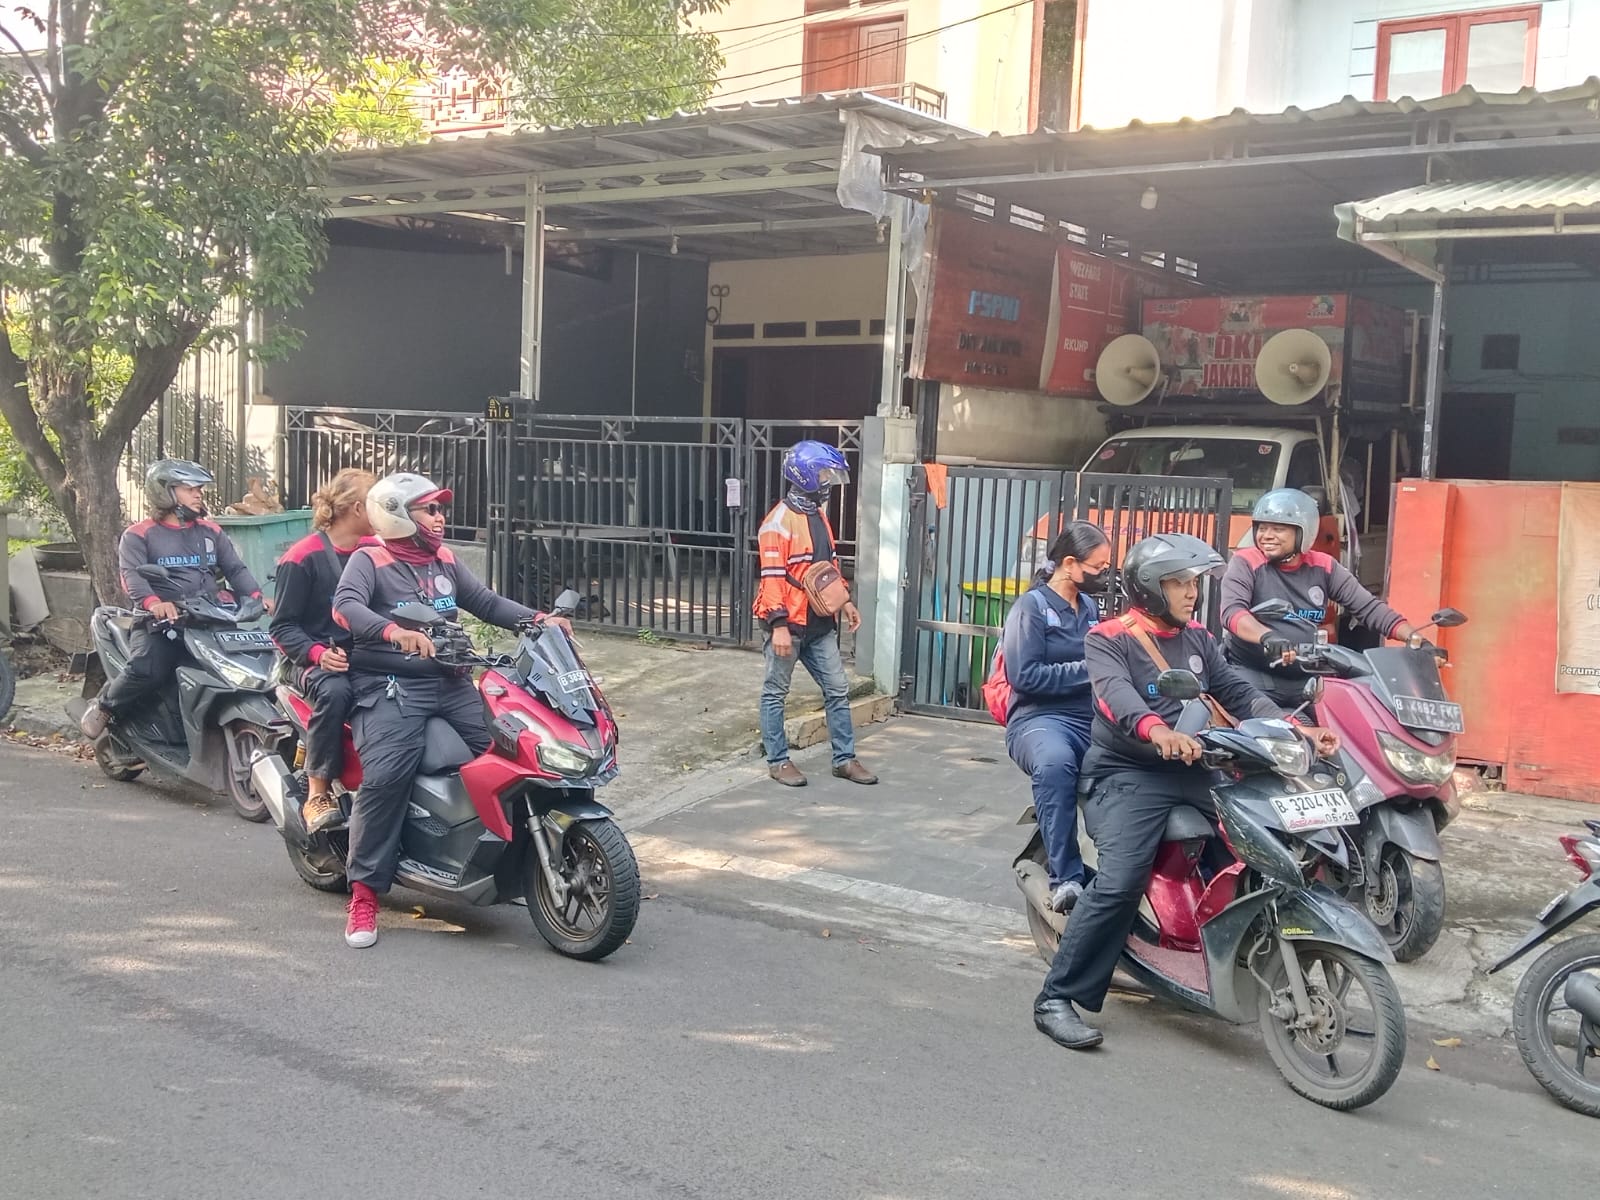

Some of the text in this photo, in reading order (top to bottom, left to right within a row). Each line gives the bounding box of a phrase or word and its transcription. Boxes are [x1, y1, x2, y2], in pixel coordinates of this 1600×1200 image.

[1069, 282, 1090, 301] STATE
[1202, 362, 1257, 388] JAKAR
[157, 554, 216, 566] GARDA MAL
[560, 677, 569, 686] B
[1395, 698, 1404, 711] B
[1275, 800, 1289, 813] B
[1290, 795, 1323, 811] 3204
